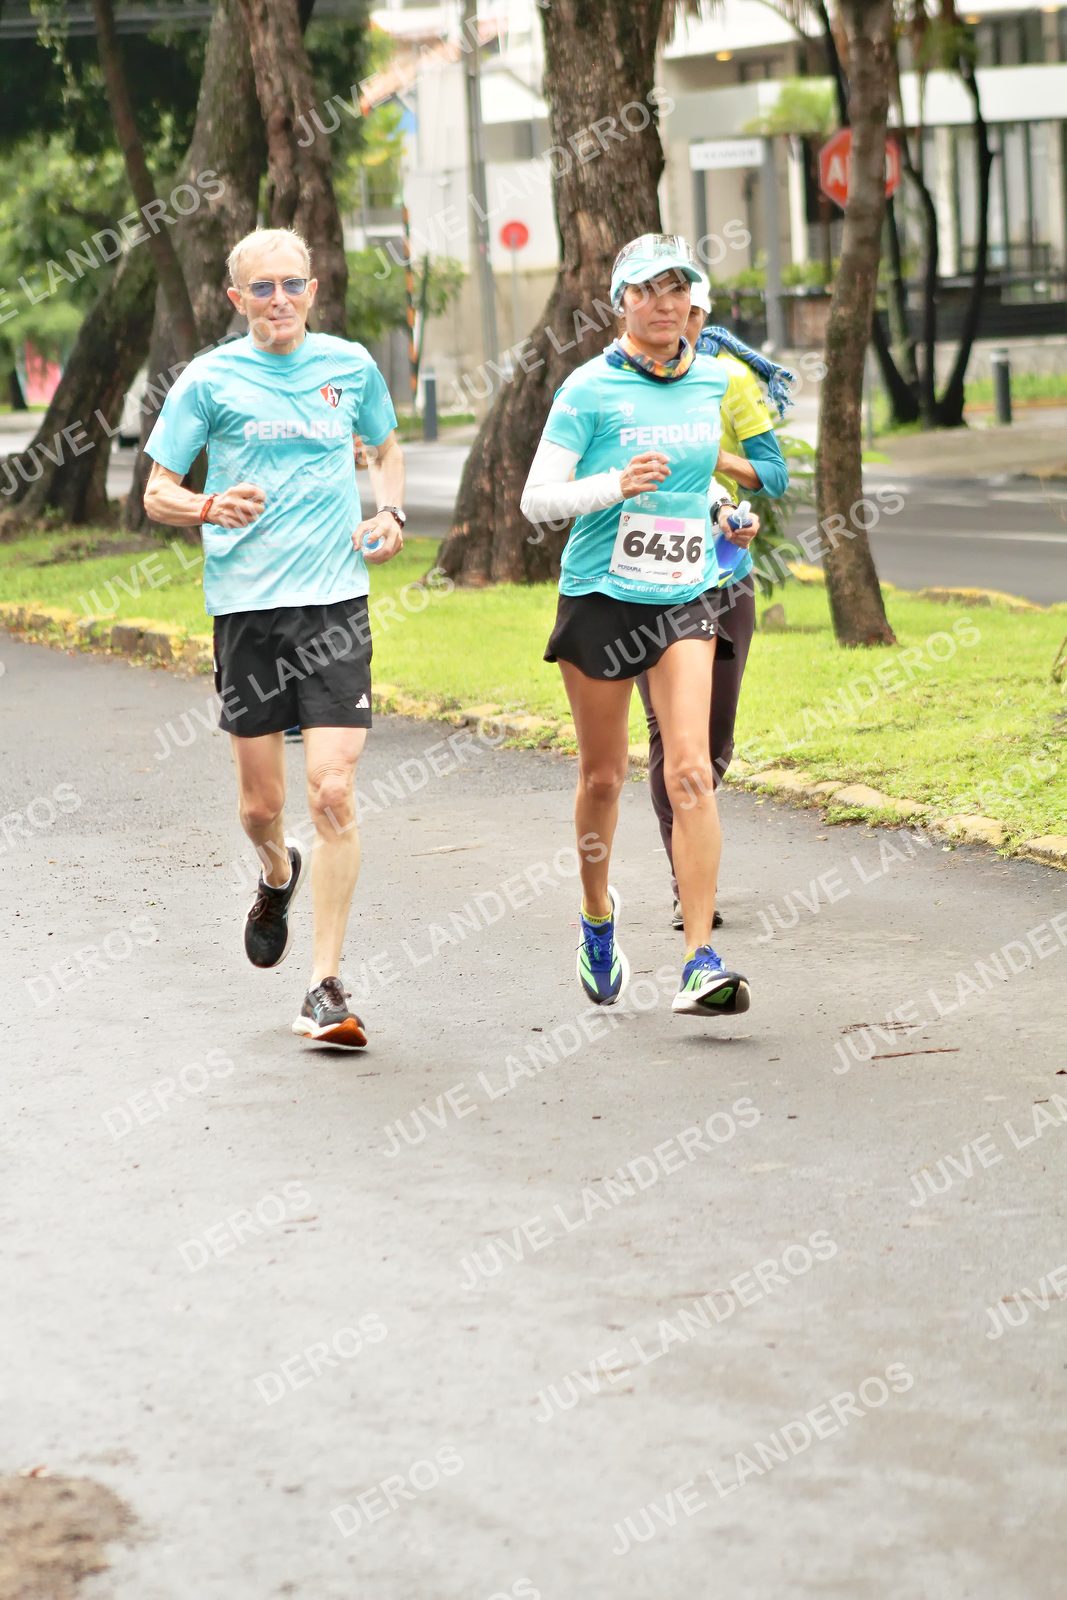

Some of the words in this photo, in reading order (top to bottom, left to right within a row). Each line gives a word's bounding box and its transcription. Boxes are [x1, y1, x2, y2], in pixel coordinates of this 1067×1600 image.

[243, 419, 345, 442] PERDURA
[620, 422, 720, 447] PERDURA
[622, 530, 703, 564] 6436
